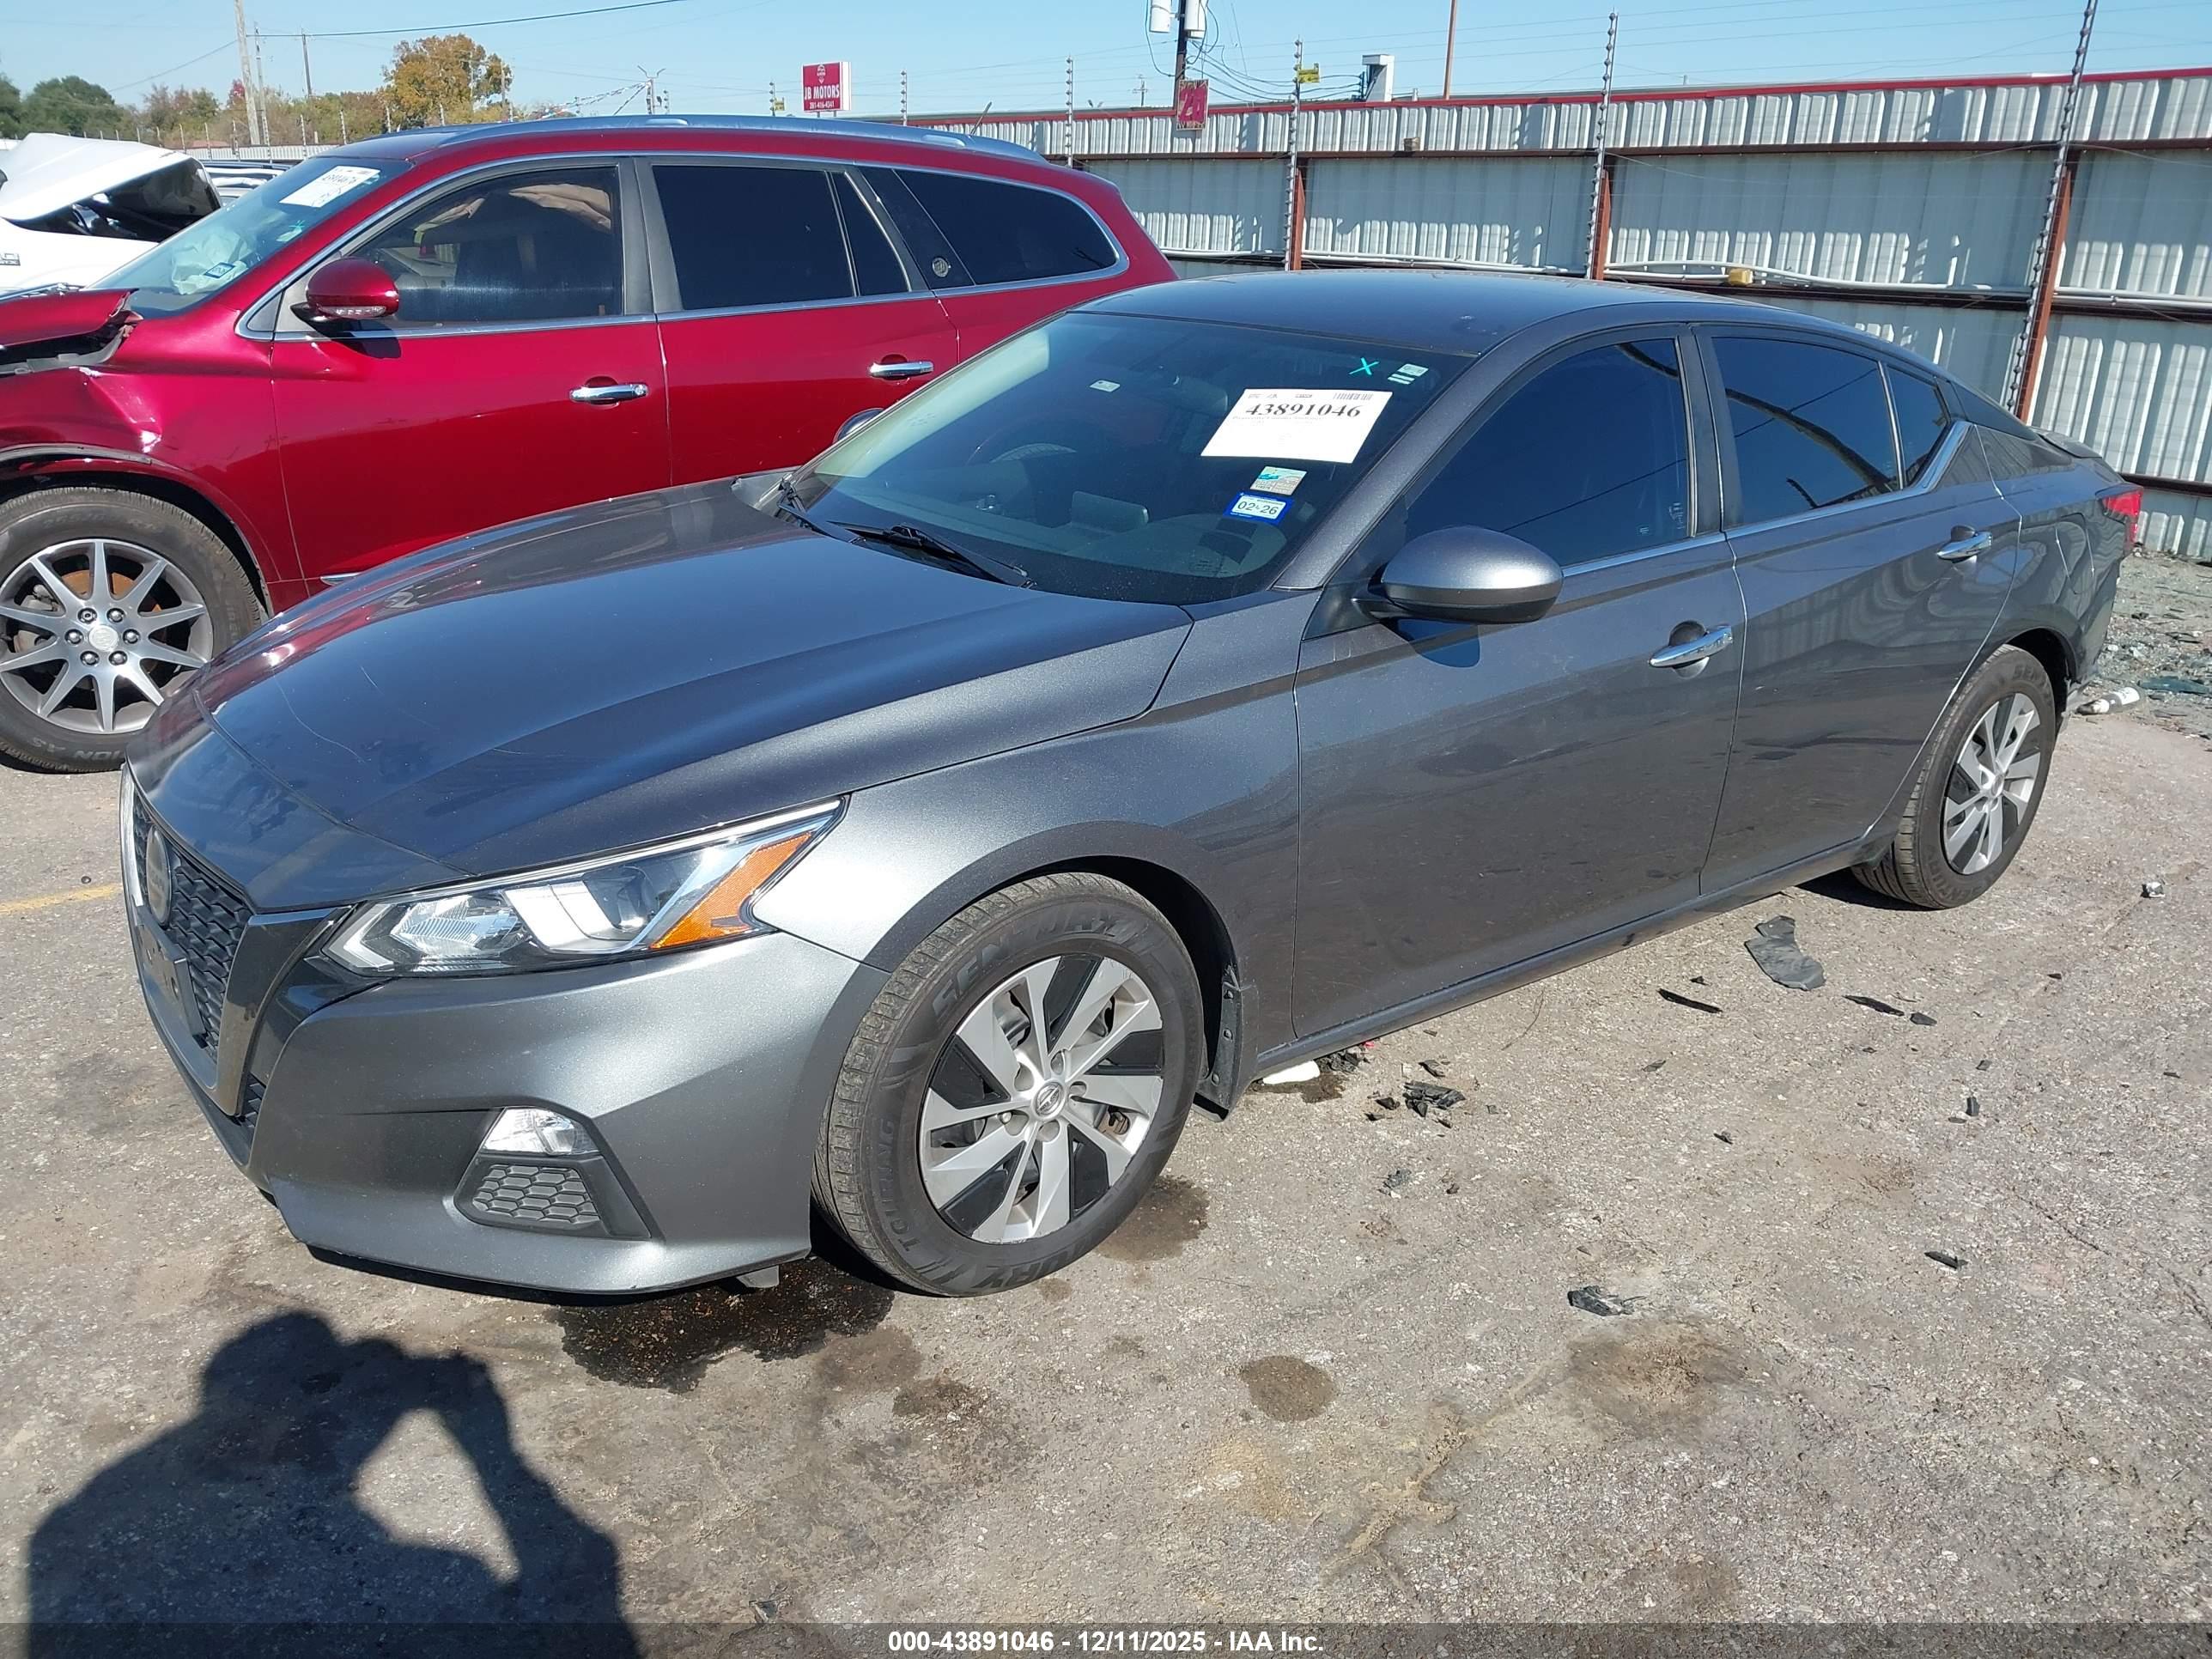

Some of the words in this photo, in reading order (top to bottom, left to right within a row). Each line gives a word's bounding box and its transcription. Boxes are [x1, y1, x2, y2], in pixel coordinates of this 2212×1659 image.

[805, 86, 812, 100] JB
[813, 84, 840, 100] MOTORS
[1245, 403, 1364, 418] 43891046
